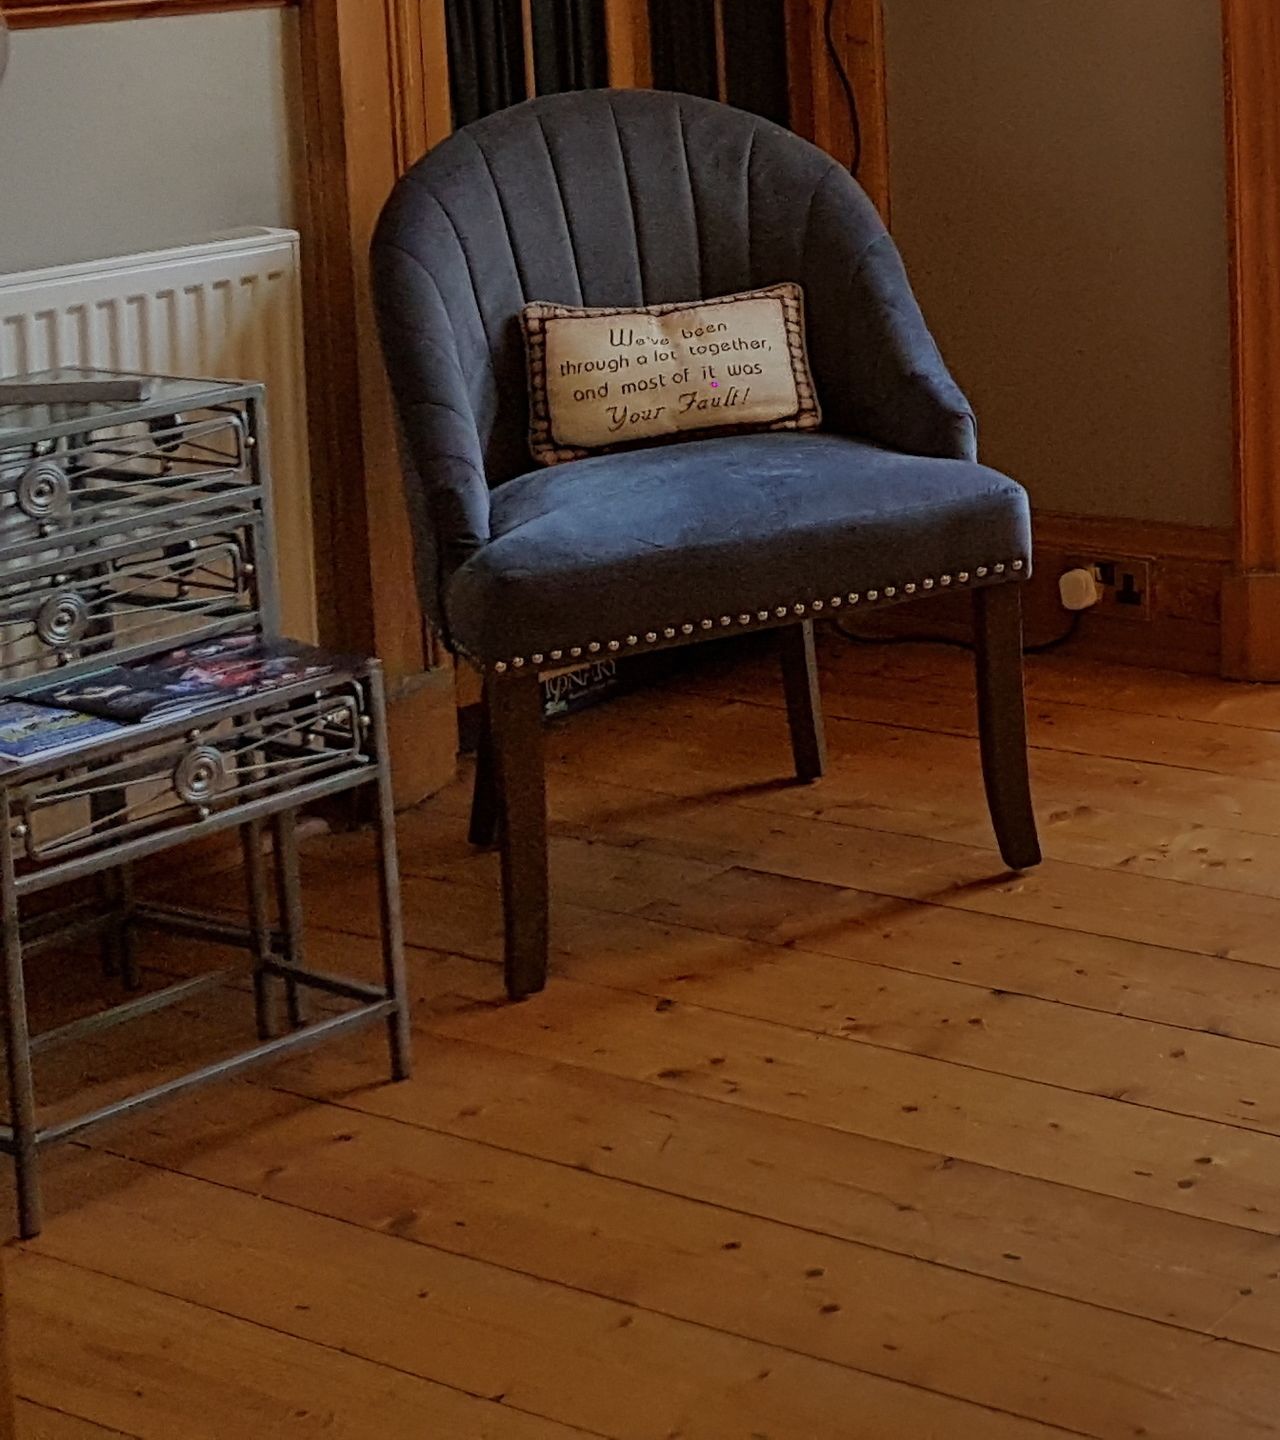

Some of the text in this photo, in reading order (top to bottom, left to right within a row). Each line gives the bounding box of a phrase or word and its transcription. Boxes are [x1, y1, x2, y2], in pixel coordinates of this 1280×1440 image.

[608, 321, 728, 348] We've been
[559, 337, 773, 378] through a lot together,
[573, 362, 764, 402] and most of it was
[605, 385, 751, 434] Your Fault!
